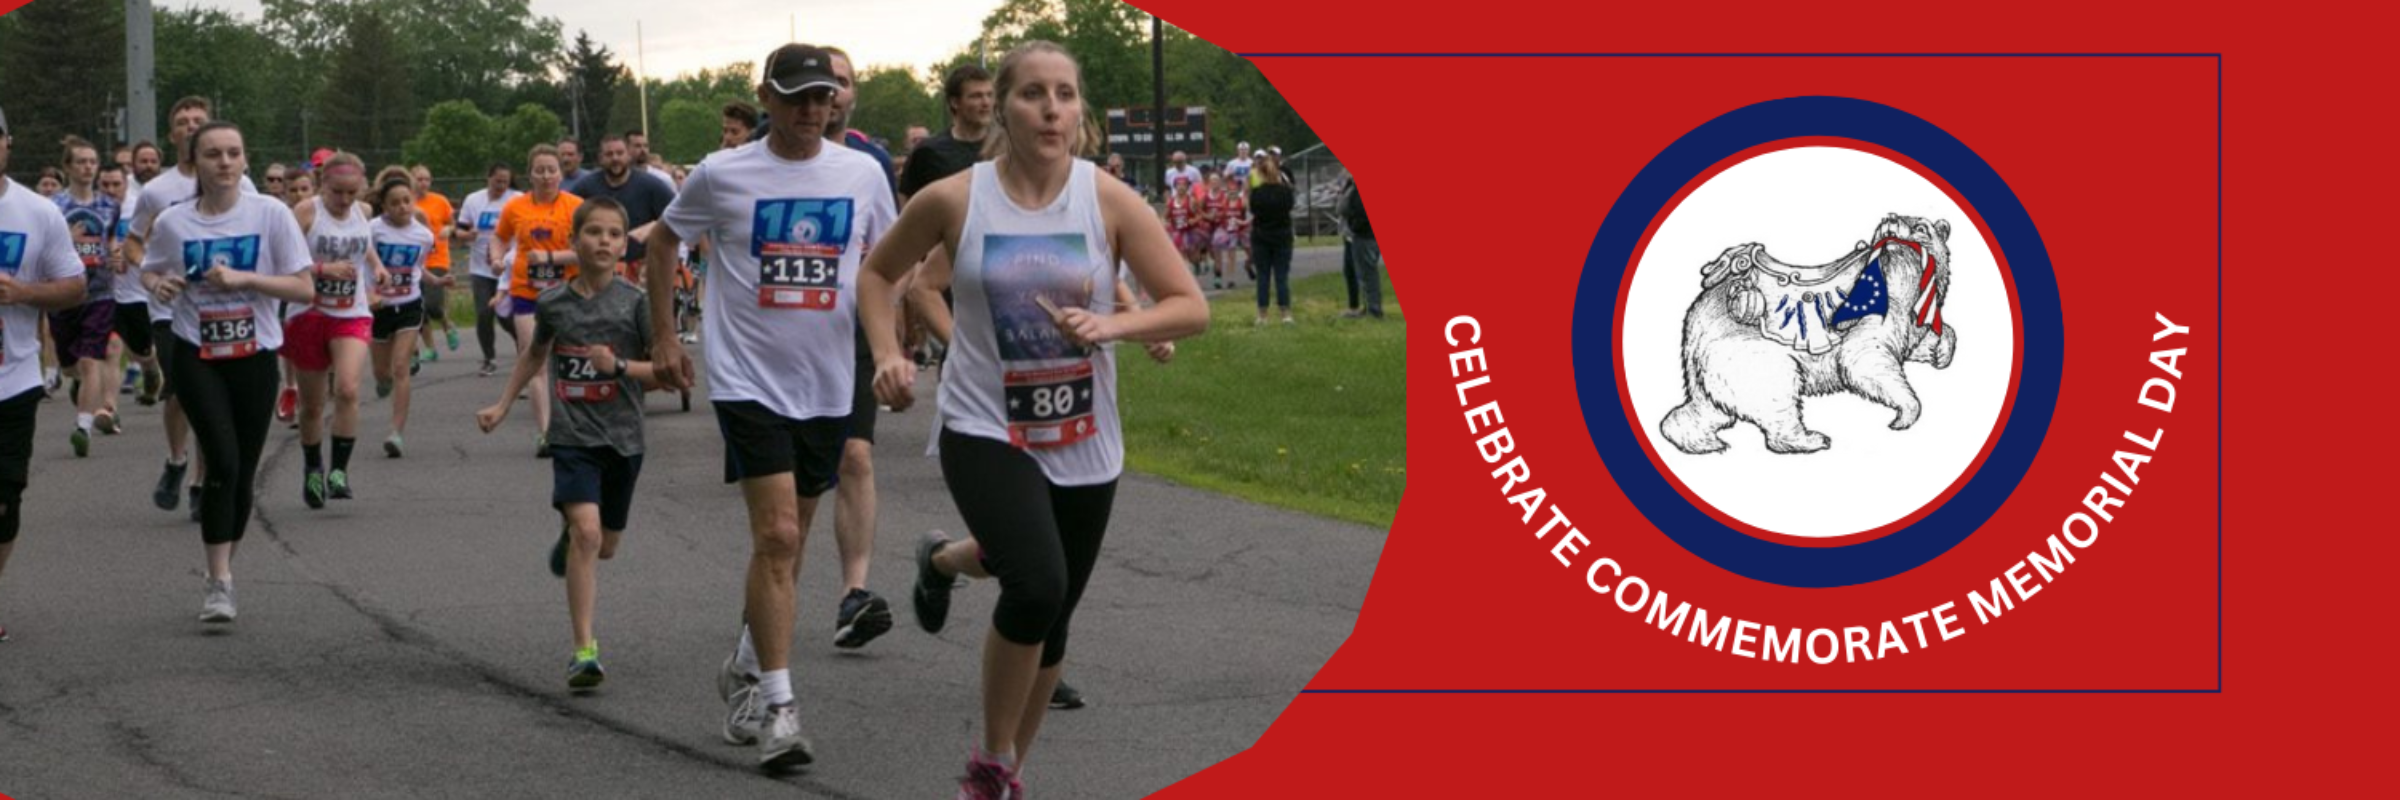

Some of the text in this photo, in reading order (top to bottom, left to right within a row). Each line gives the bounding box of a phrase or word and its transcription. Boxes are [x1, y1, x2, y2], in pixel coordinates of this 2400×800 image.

[760, 201, 848, 243] 151
[773, 258, 826, 283] 113
[323, 281, 351, 295] 216
[210, 321, 248, 340] 136
[568, 358, 598, 379] 24
[1033, 385, 1074, 417] 80
